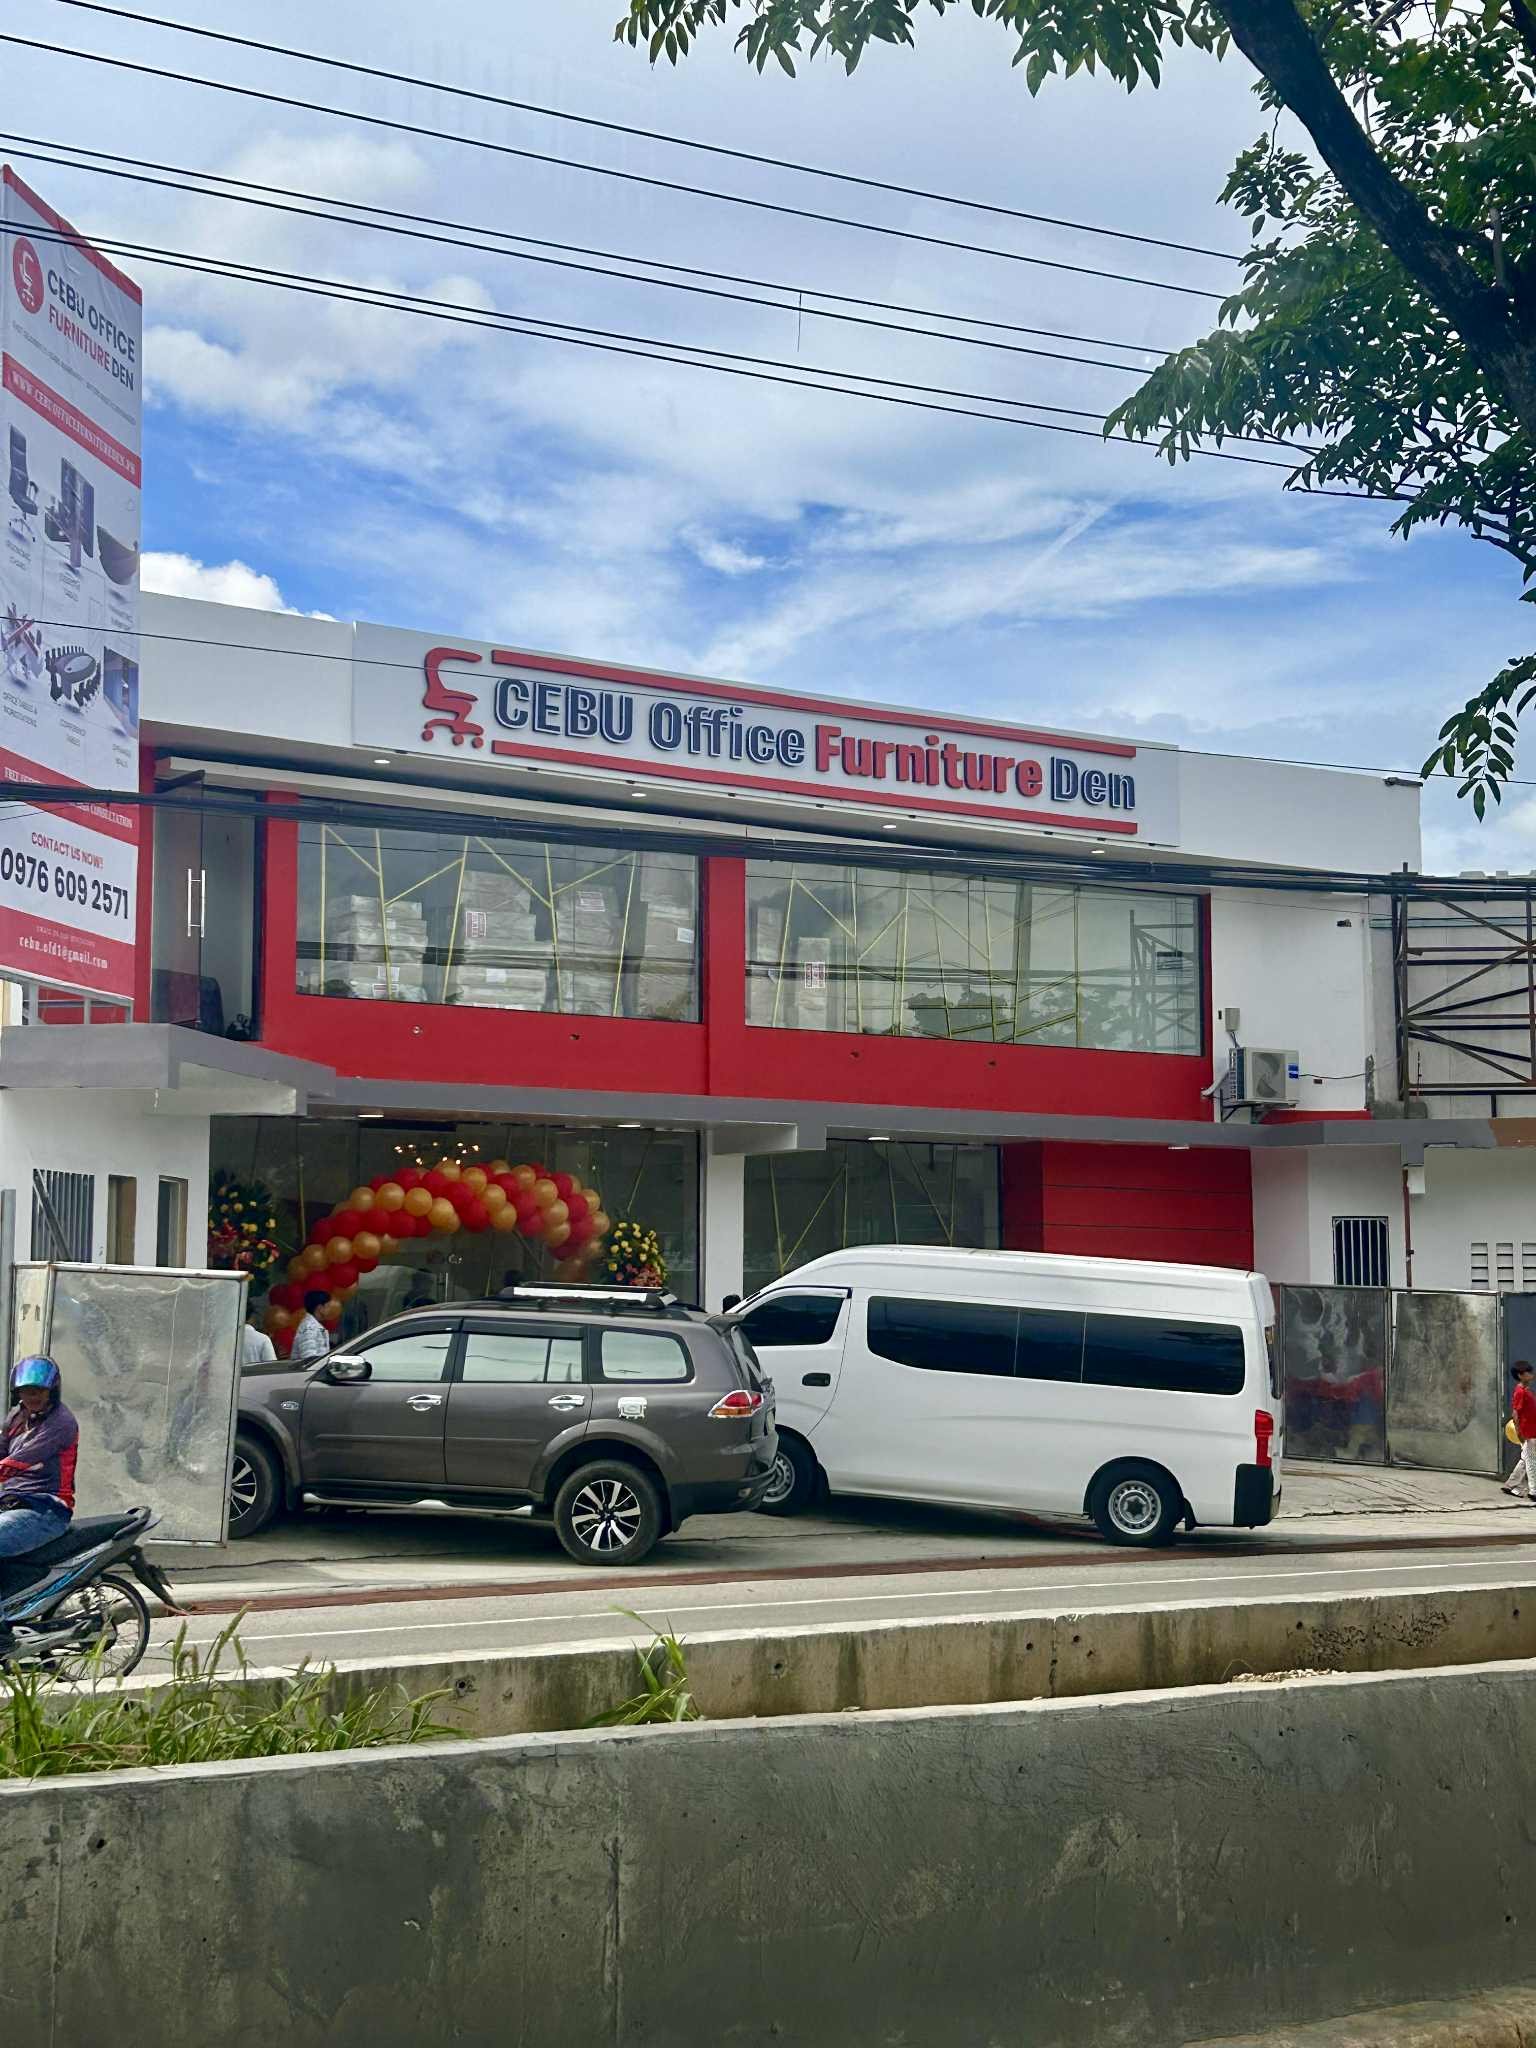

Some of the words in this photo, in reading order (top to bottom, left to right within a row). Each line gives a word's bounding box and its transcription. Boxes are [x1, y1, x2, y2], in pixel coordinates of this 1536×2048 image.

[48, 269, 84, 318] CEBU
[88, 305, 135, 362] OFFICE
[49, 304, 110, 371] FURNITURE
[112, 356, 134, 391] DEN
[495, 678, 633, 744] CEBU
[649, 701, 806, 767] Office
[815, 724, 1043, 797] Furniture
[1050, 756, 1136, 810] Den
[1, 848, 48, 892] 0976
[55, 866, 87, 905] 609
[91, 880, 128, 919] 2571
[32, 832, 69, 856] CONTACT
[71, 846, 81, 860] US
